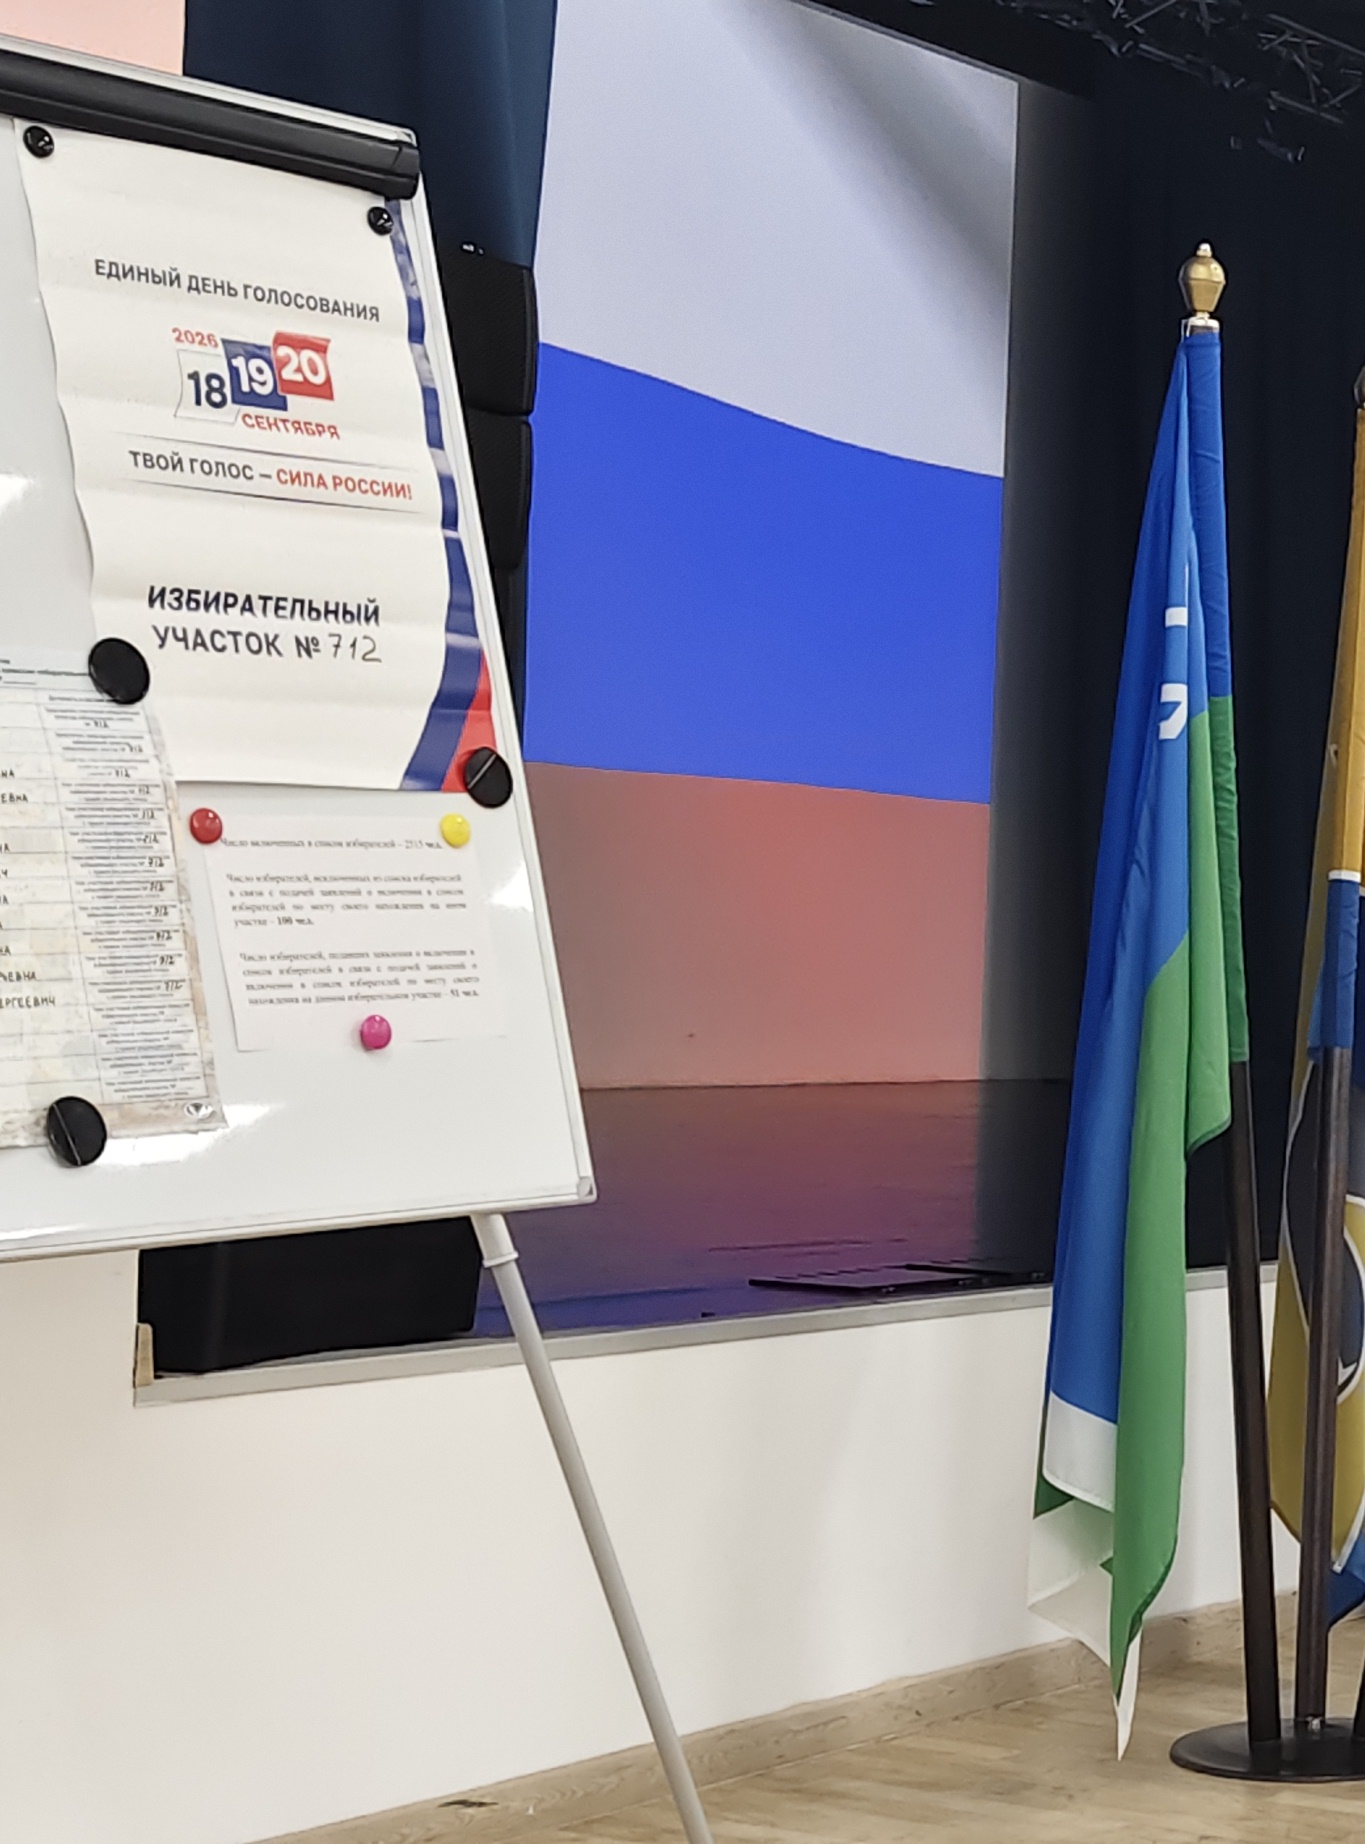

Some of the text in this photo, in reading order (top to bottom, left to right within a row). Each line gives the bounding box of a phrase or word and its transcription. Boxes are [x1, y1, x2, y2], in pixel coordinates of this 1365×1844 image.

[94, 258, 381, 322] ЕДИНЫЙ ДЕНЬ ГОЛОСОВАНИЯ
[171, 327, 219, 349] 2026
[187, 344, 328, 410] 18 19 20
[241, 413, 341, 441] СЕНТЯБРЯ
[128, 450, 184, 473] ТВОЙ
[189, 457, 255, 481] ГОЛОС
[276, 468, 329, 491] СИЛА
[331, 474, 413, 501] РОССИИ!
[147, 585, 381, 628] ИЗБИРАТЕЛЬНЫЙ
[151, 624, 382, 664] УЧАСТОК № 712
